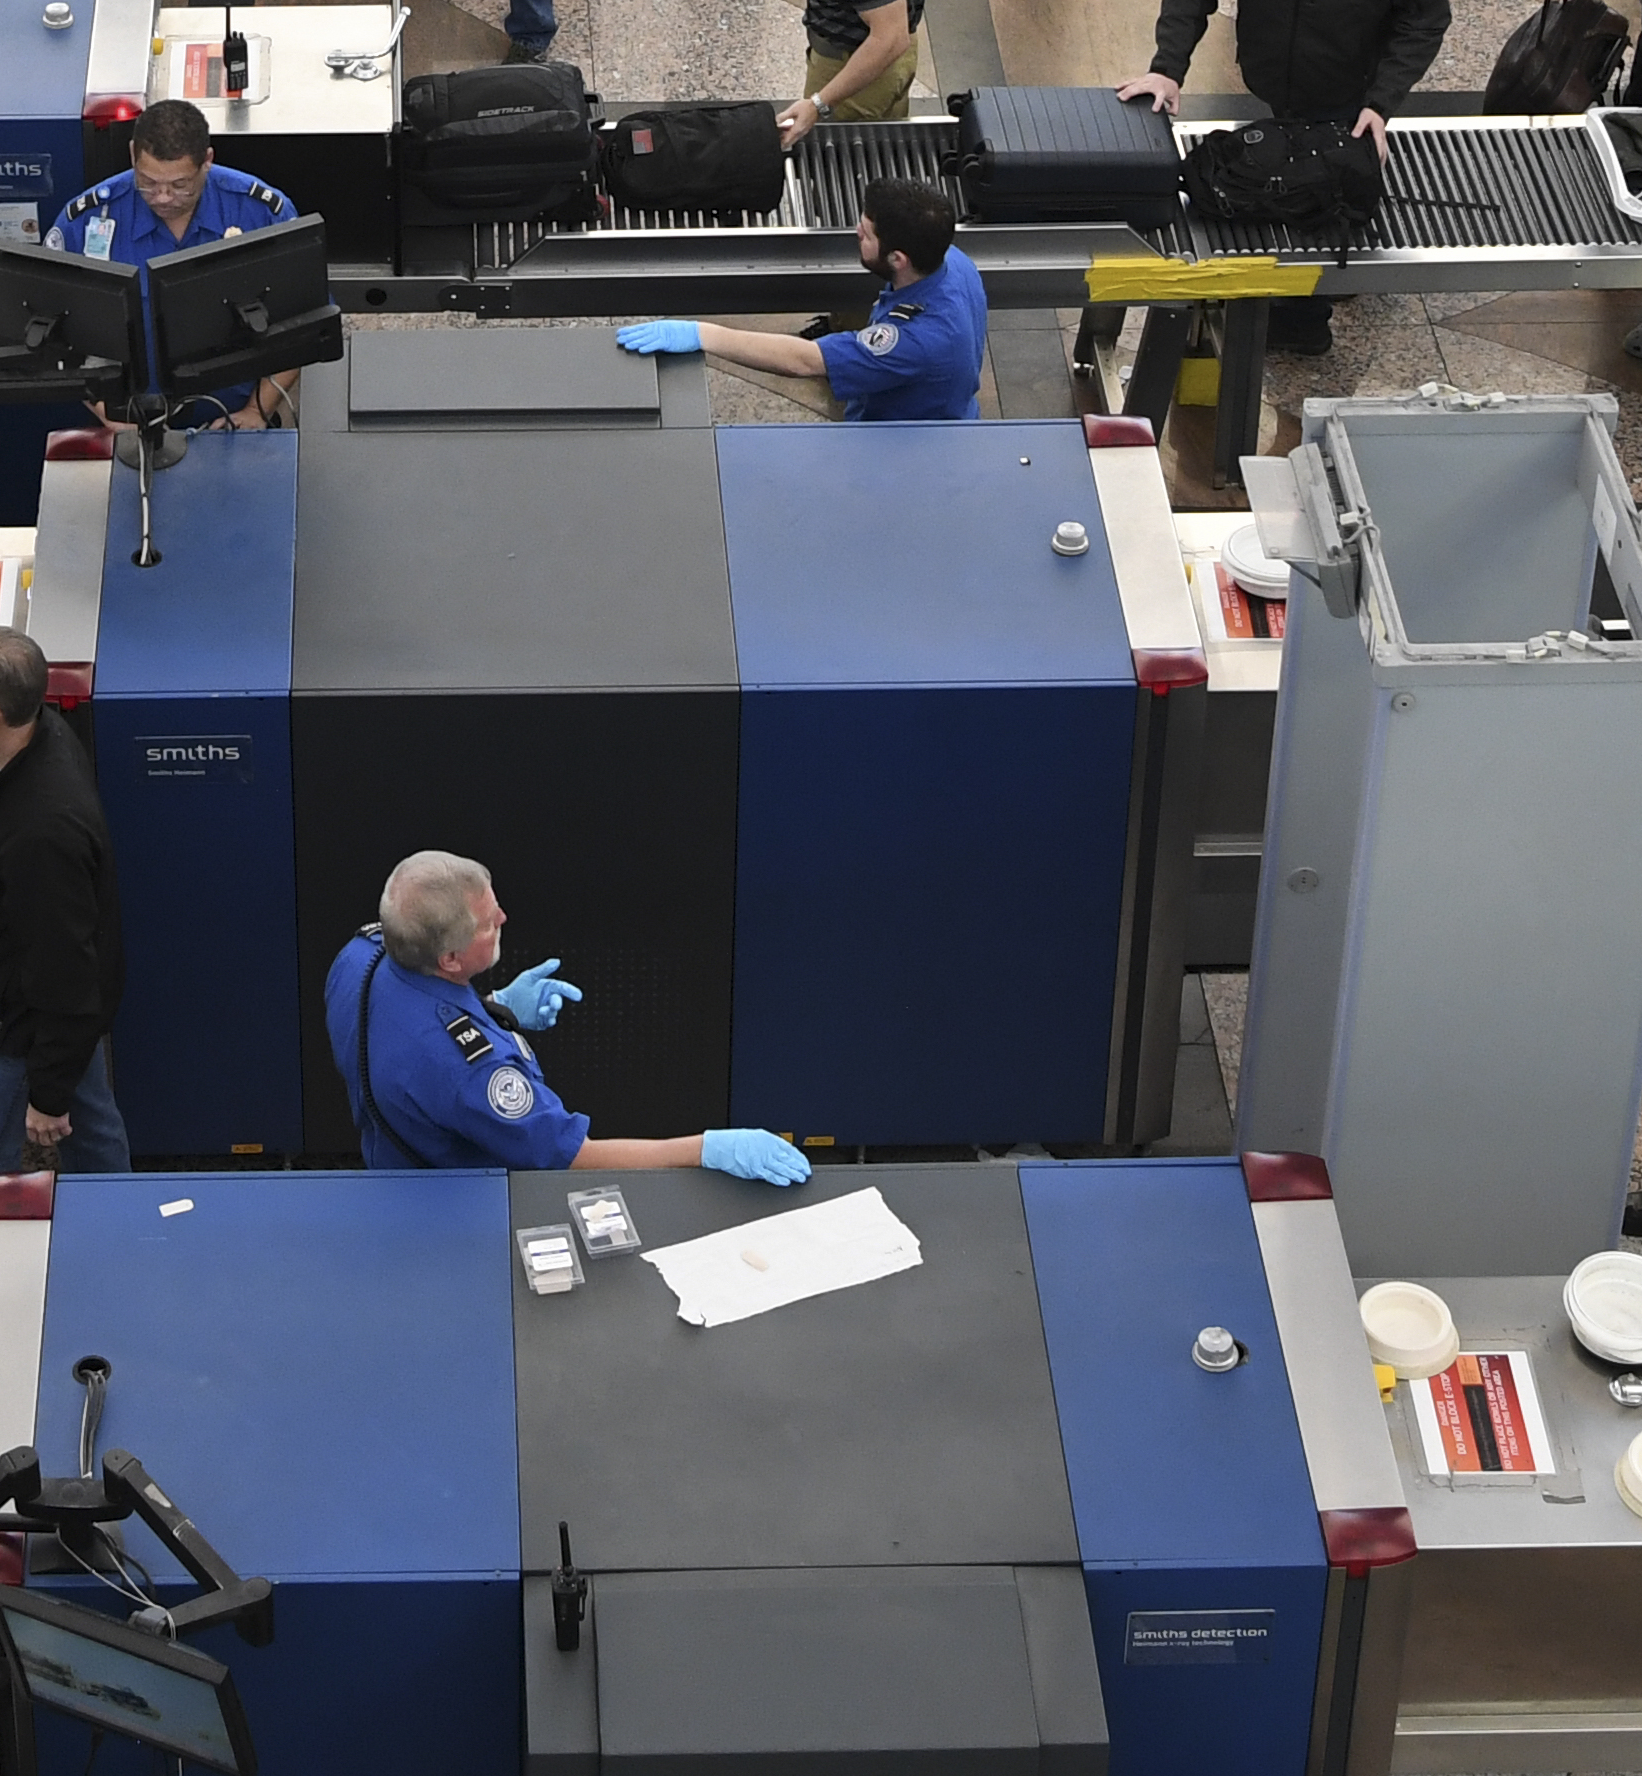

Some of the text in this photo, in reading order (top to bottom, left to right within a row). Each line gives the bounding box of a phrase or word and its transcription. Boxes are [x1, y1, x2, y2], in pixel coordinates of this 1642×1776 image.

[477, 106, 535, 118] SIDETRACK
[146, 744, 240, 761] smiths
[455, 1027, 481, 1046] TSA
[1439, 1373, 1467, 1455] DO NOT BLOCK E-STOP
[1479, 1356, 1513, 1470] DO NOT PLACE BOWLS OR ANY OTHER
[1502, 1411, 1513, 1425] THIS
[1506, 1426, 1515, 1437] ON
[1508, 1437, 1519, 1456] ITEMS
[1133, 1628, 1268, 1640] smiths detection
